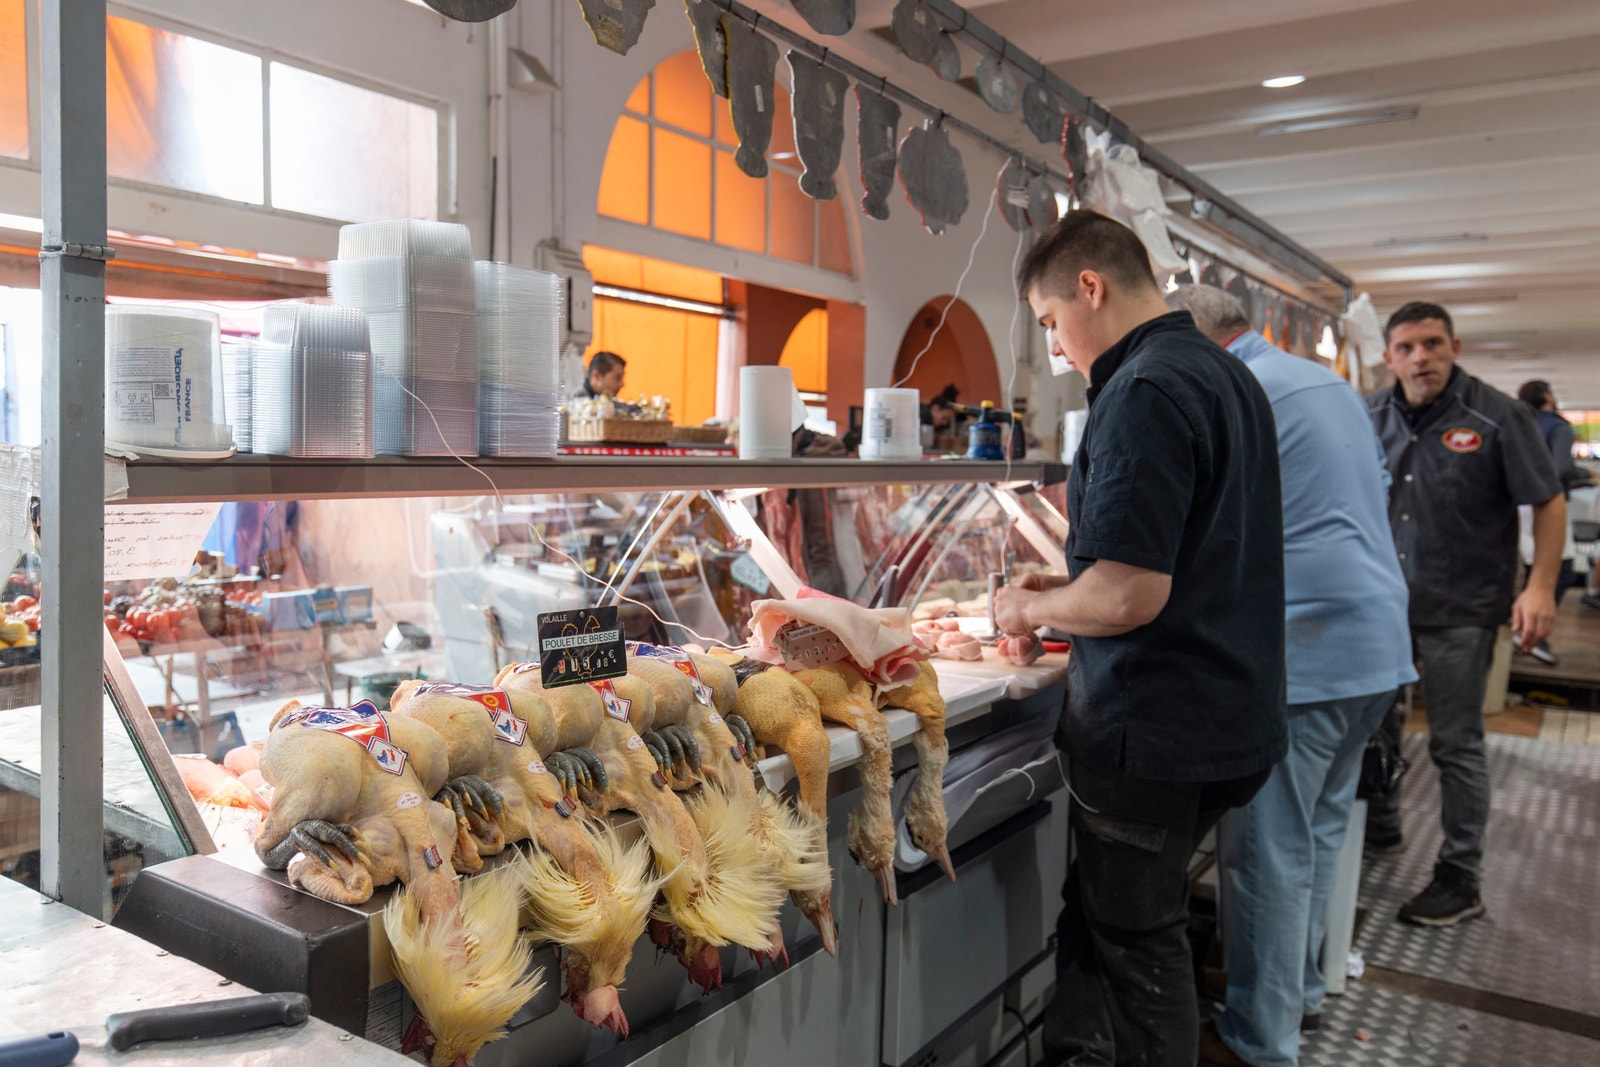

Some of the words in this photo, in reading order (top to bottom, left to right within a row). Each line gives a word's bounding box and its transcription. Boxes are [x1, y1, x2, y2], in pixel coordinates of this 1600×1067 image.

[541, 614, 567, 624] VOLAILLE
[545, 637, 576, 648] POULET
[576, 636, 588, 645] DE
[588, 631, 617, 644] BRESSE
